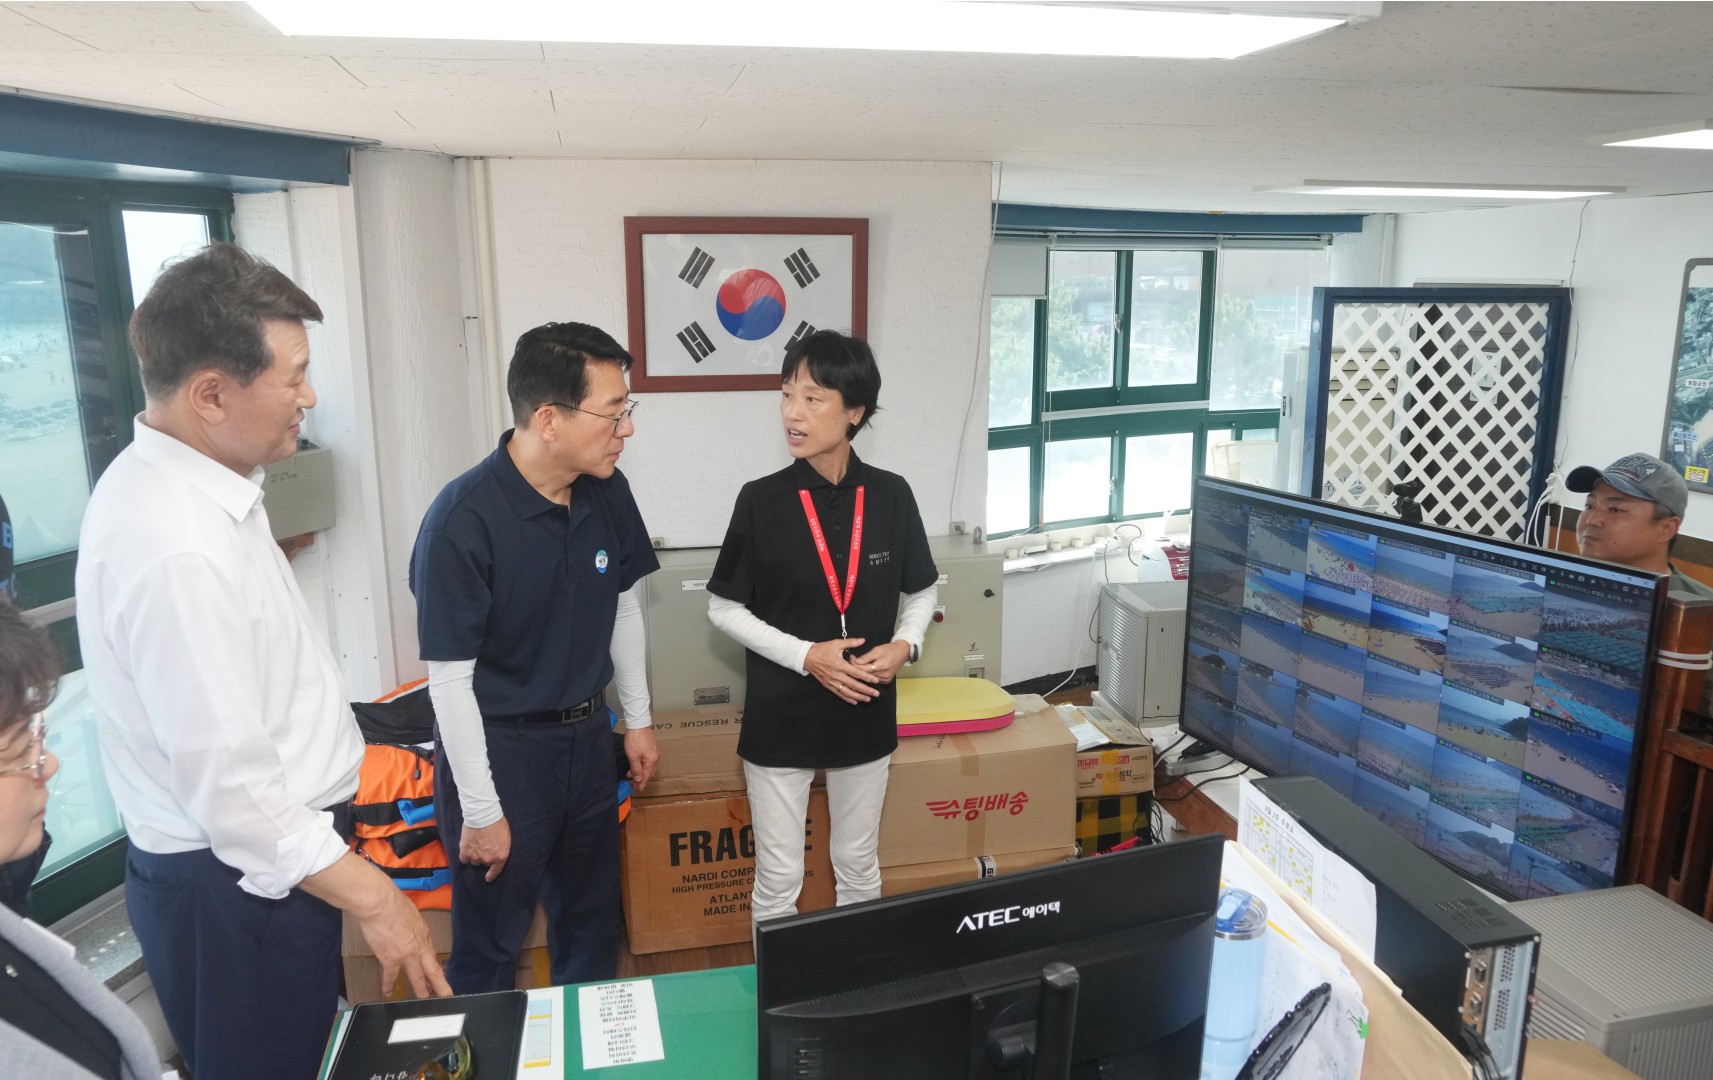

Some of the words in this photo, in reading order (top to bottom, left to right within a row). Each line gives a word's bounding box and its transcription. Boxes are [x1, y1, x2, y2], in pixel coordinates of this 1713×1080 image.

[680, 718, 728, 730] RESCUE
[925, 791, 1029, 821] 슈팅배송
[682, 872, 718, 884] NARDI
[672, 883, 694, 894] HIGH
[697, 879, 744, 891] PRESSURE
[703, 904, 737, 916] MADE
[739, 902, 751, 912] IN
[956, 905, 1021, 934] ATEC
[1022, 901, 1061, 919] 에이텍
